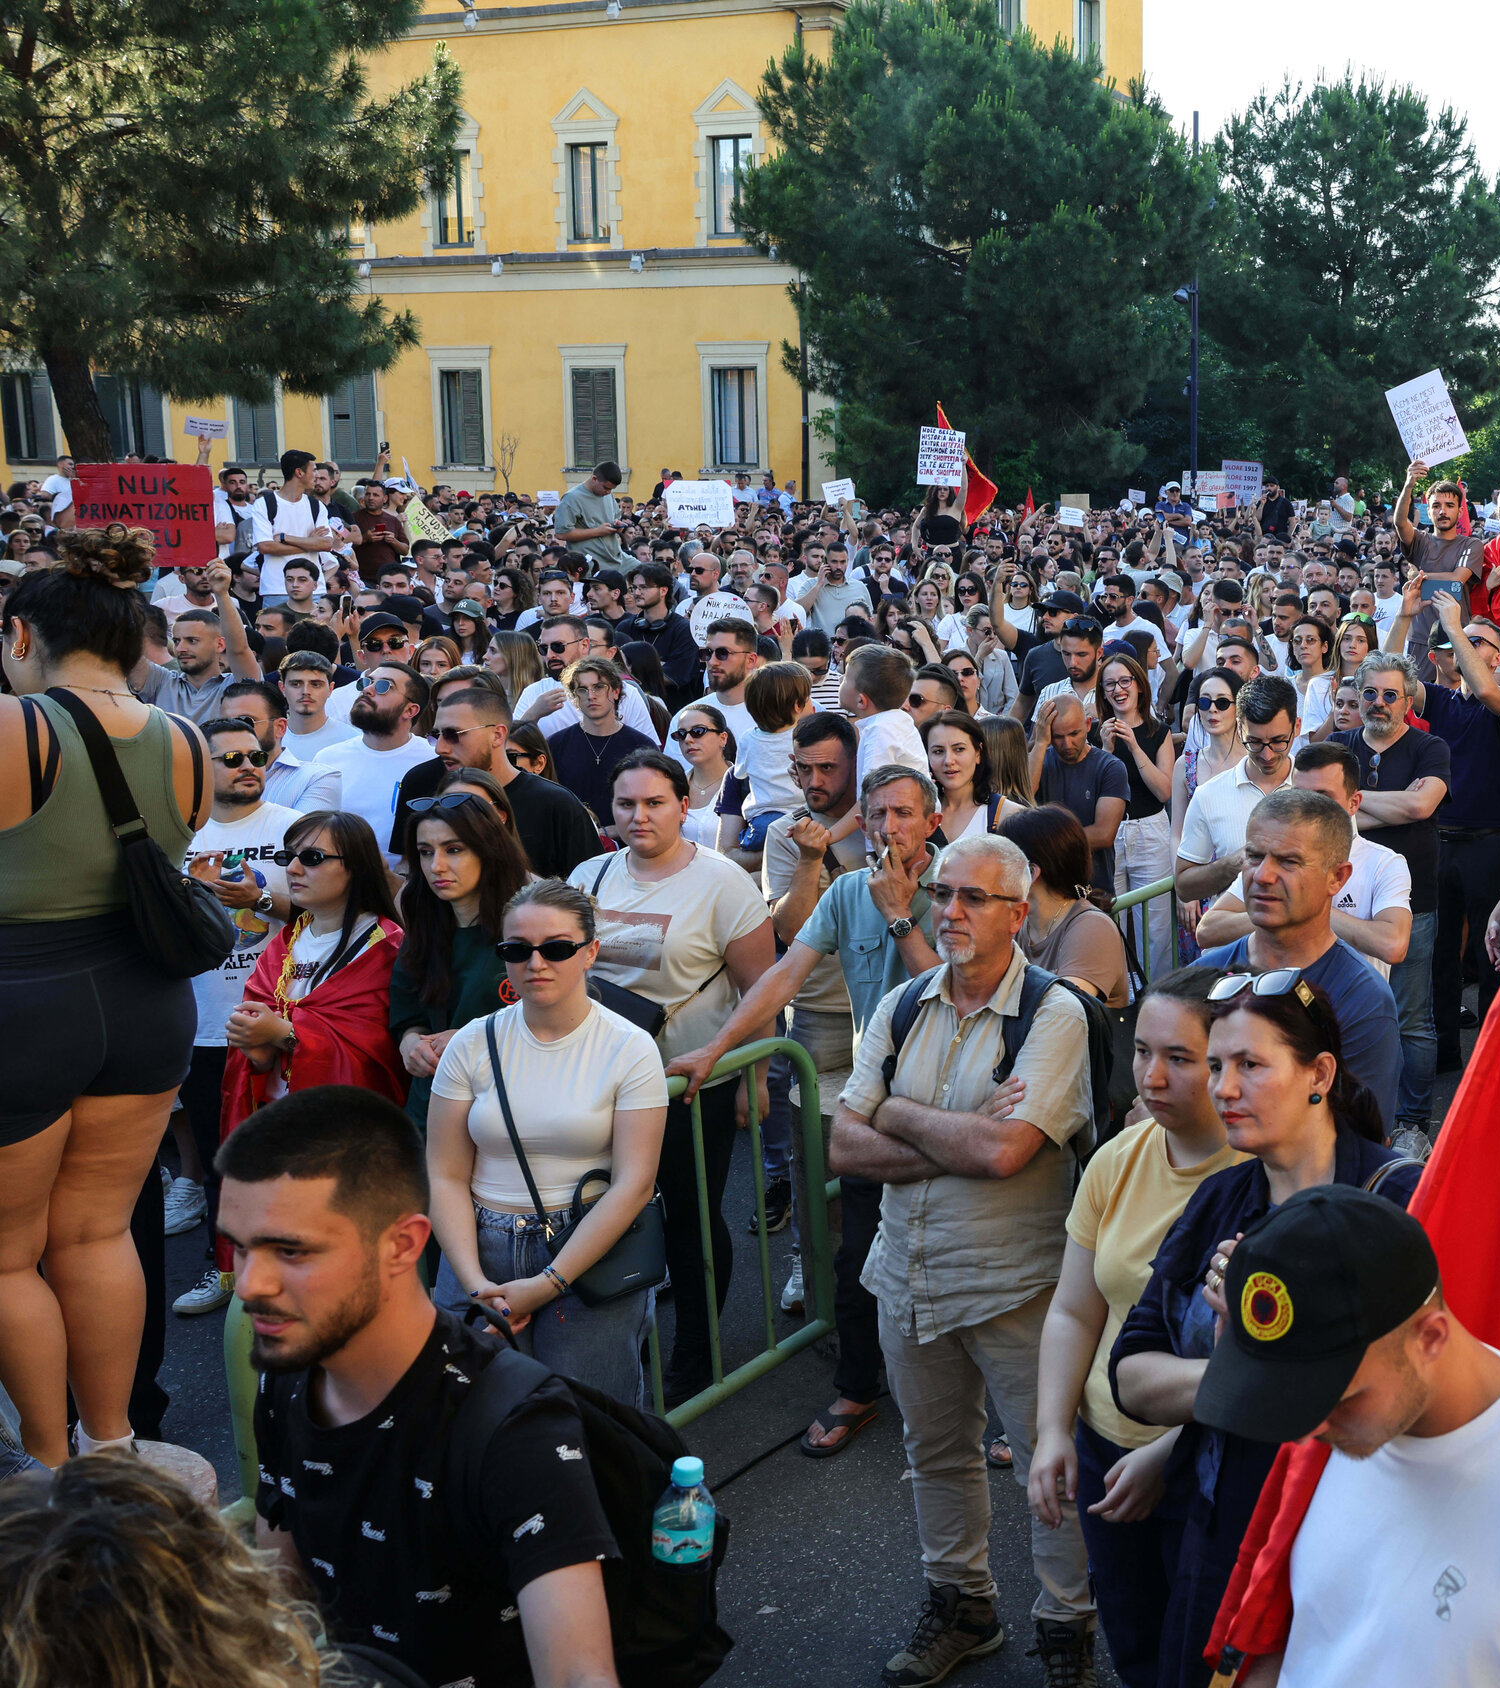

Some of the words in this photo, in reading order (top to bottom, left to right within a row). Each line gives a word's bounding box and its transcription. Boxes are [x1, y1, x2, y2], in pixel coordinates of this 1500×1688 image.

[1244, 465, 1259, 473] 1912
[118, 475, 179, 496] NUK
[77, 503, 210, 521] PRIVATIZOHET
[418, 507, 450, 540] STUDIM
[223, 960, 251, 970] ALL.
